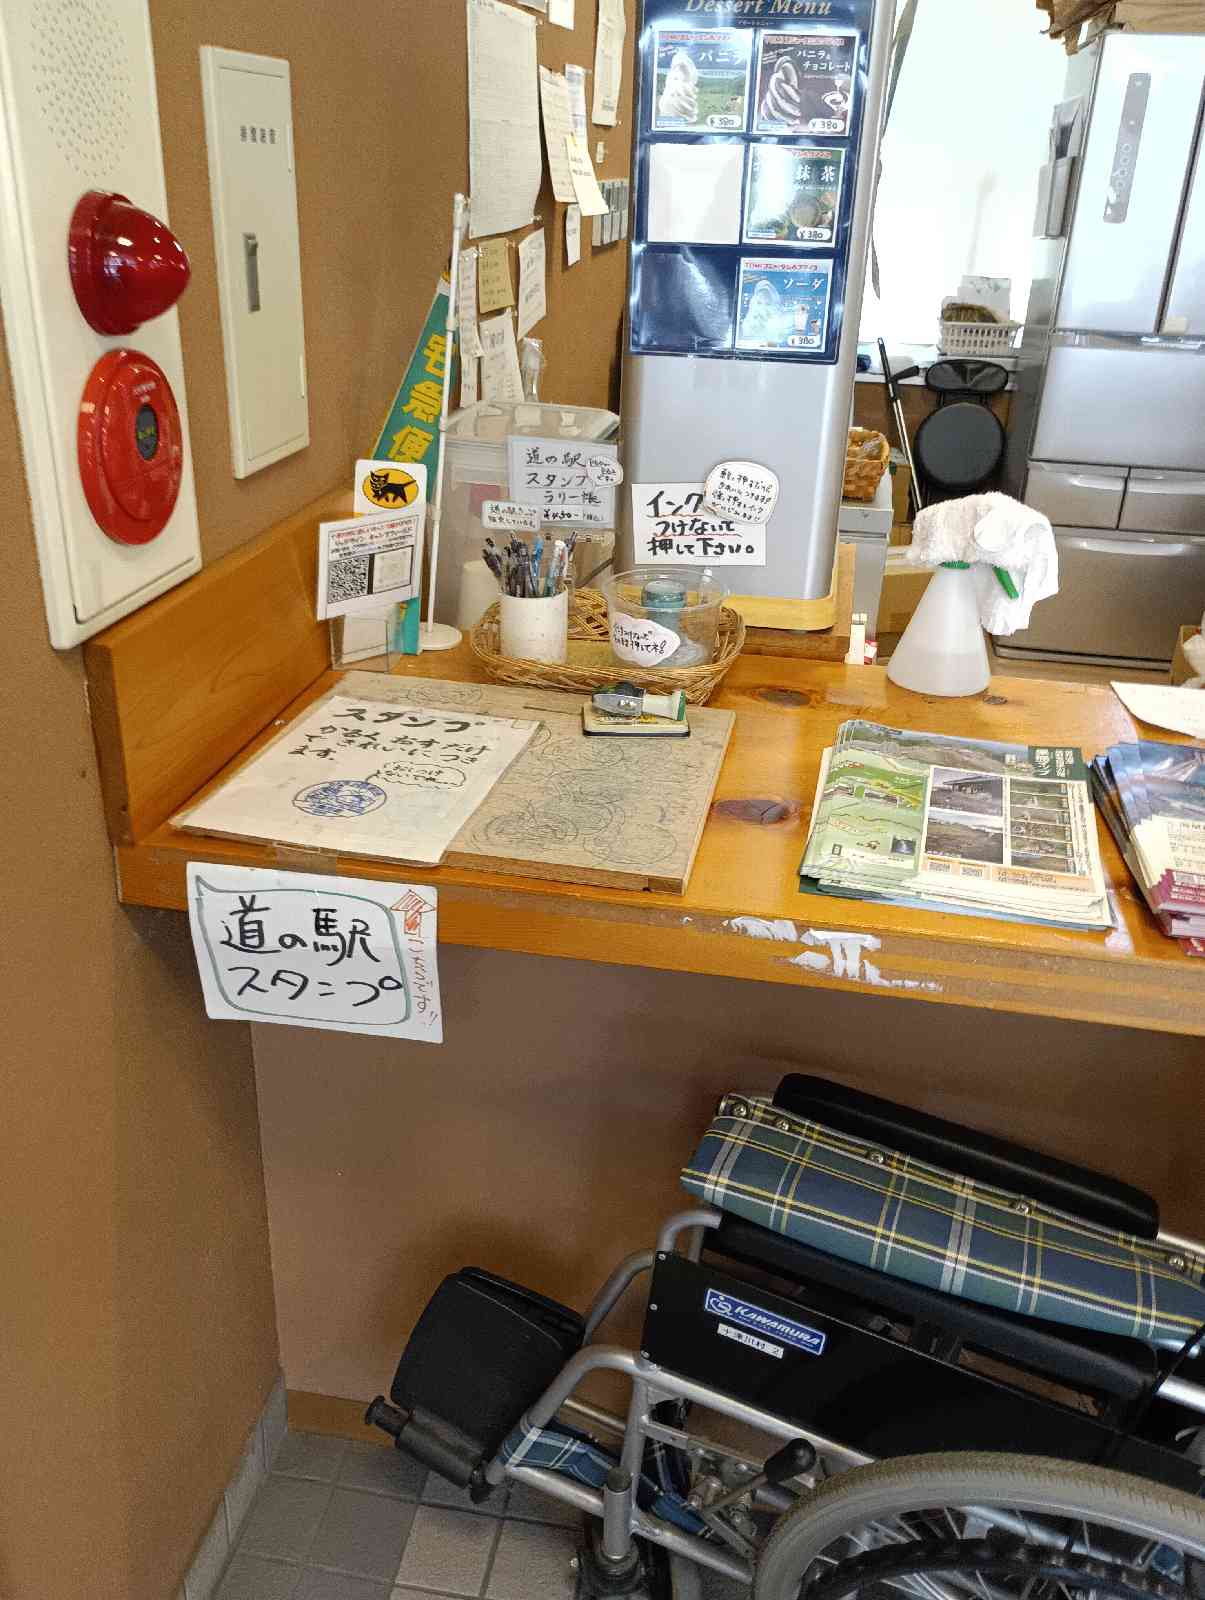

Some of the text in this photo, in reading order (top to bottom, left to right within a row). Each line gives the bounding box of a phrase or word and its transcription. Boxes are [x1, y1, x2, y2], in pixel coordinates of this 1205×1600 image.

[685, 0, 831, 15] Dessert Menu
[803, 61, 852, 73] チョコレート
[783, 277, 825, 290] ソーダ
[525, 447, 586, 468] 道の駅
[646, 490, 704, 518] インク
[332, 708, 486, 733] スタンプ
[220, 895, 380, 966] 道の駅
[227, 966, 403, 1007] スタンプ
[734, 1305, 821, 1345] KAWAMURA
